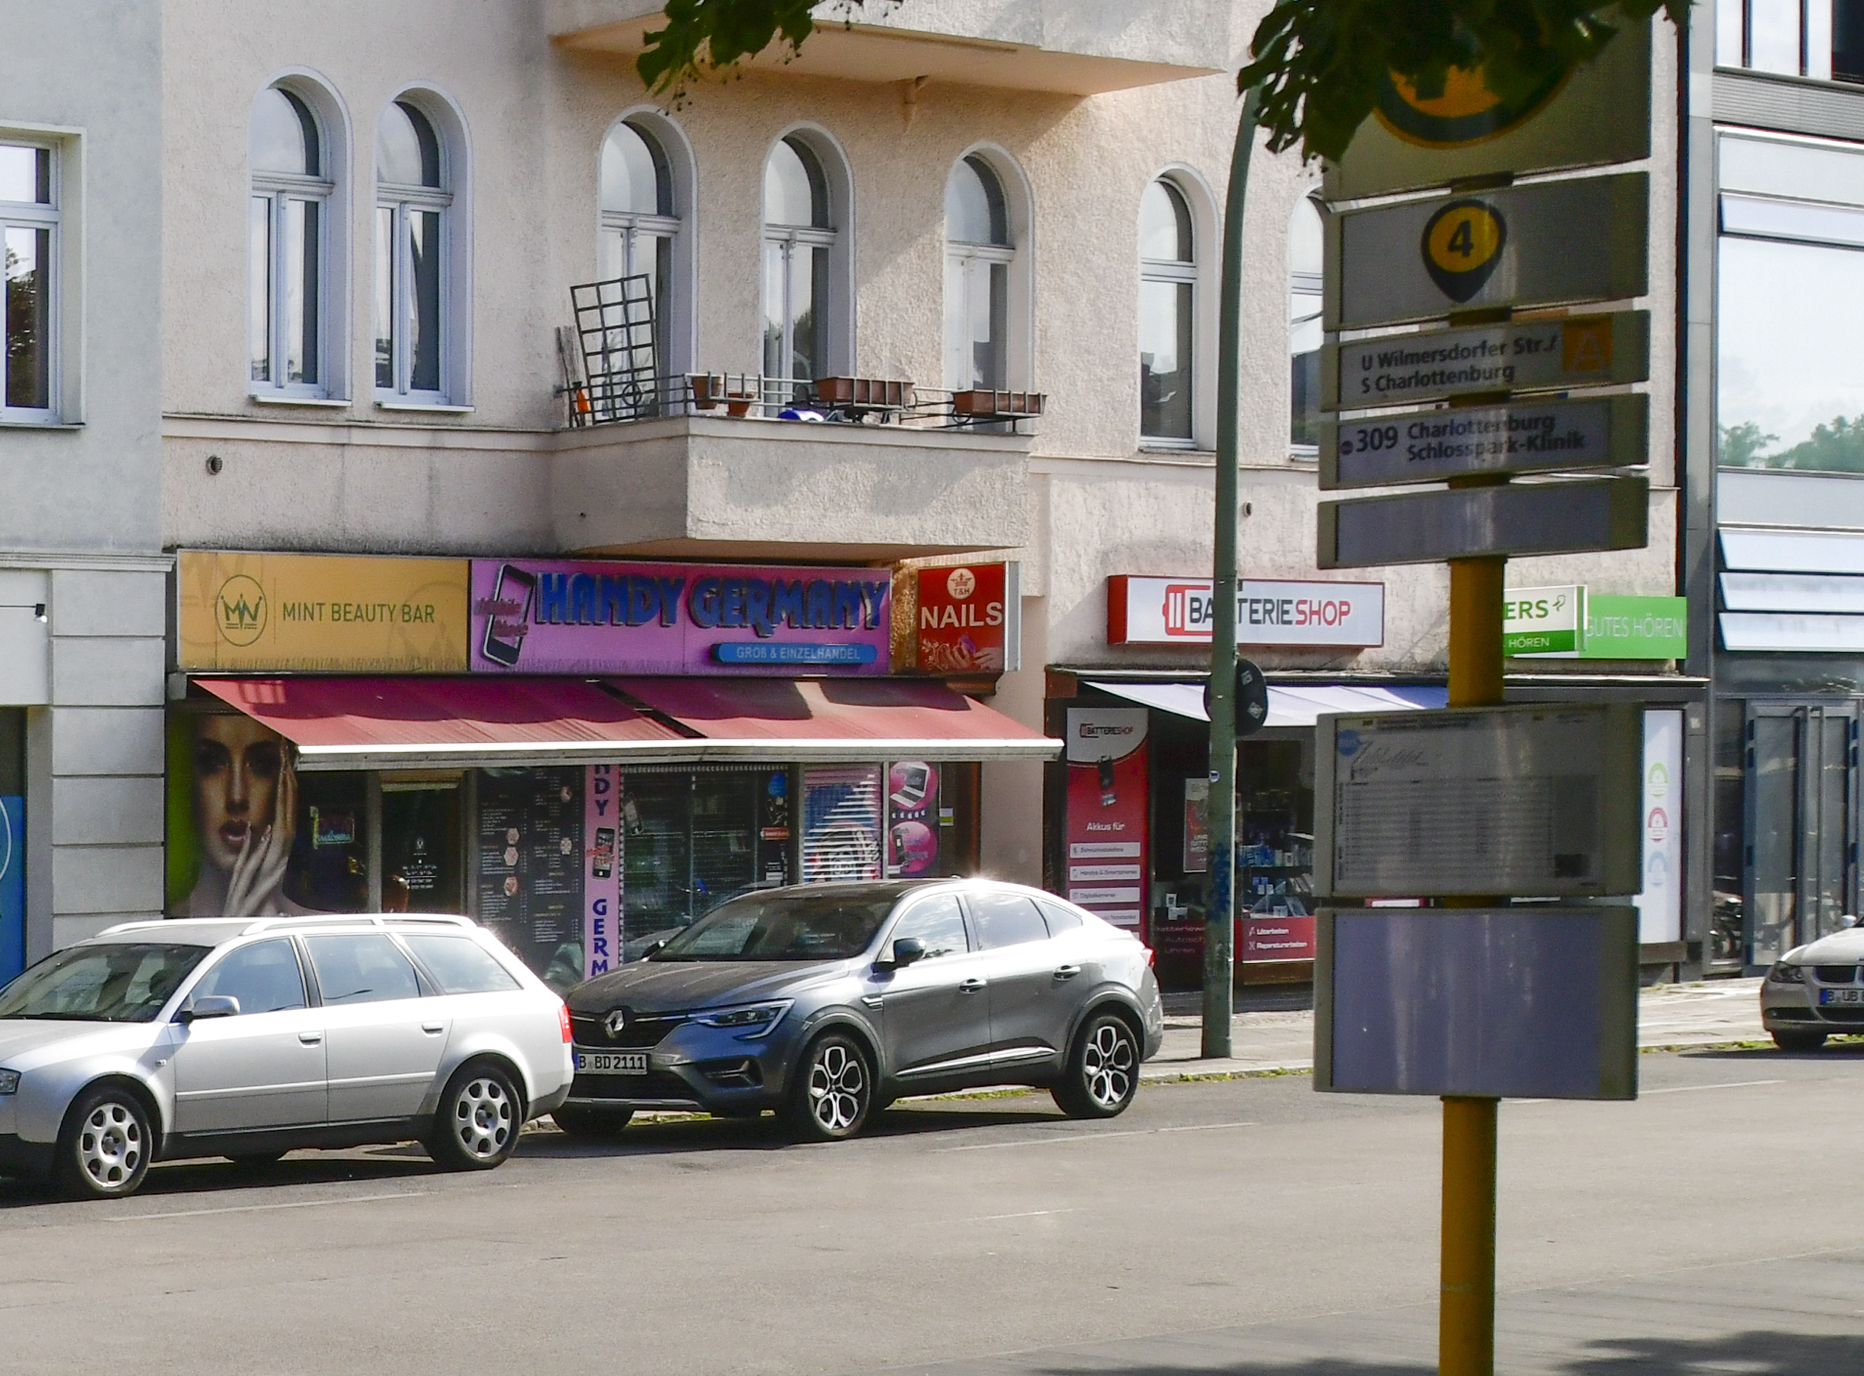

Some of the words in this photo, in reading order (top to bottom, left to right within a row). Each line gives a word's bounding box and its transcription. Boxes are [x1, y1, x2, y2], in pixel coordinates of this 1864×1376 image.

[1361, 354, 1372, 372] U
[1376, 338, 1507, 368] Wilmersdorfer
[1513, 333, 1560, 356] Str./
[1361, 377, 1371, 394] S
[1375, 364, 1516, 393] Charlottenburg
[1356, 426, 1399, 453] 309
[1407, 414, 1557, 440] Charlottenburg
[1407, 431, 1586, 462] Schlosspark-Klinik
[282, 602, 326, 622] MINT
[331, 603, 396, 623] BEAUTY
[402, 604, 435, 623] BAR
[535, 572, 685, 626] HANDY
[688, 576, 890, 638] GERMANY
[921, 602, 1003, 630] NAILS
[1189, 597, 1351, 626] BATERIESHOP
[1587, 616, 1629, 638] GUTES
[1633, 613, 1683, 638] HÖREN
[779, 647, 861, 660] EINZELHANDEL
[1508, 636, 1550, 648] HÖREN
[1086, 822, 1112, 831] Akkus
[1113, 821, 1125, 830] für
[579, 1055, 586, 1069] B
[595, 1056, 611, 1069] BD
[613, 1056, 645, 1070] 2111
